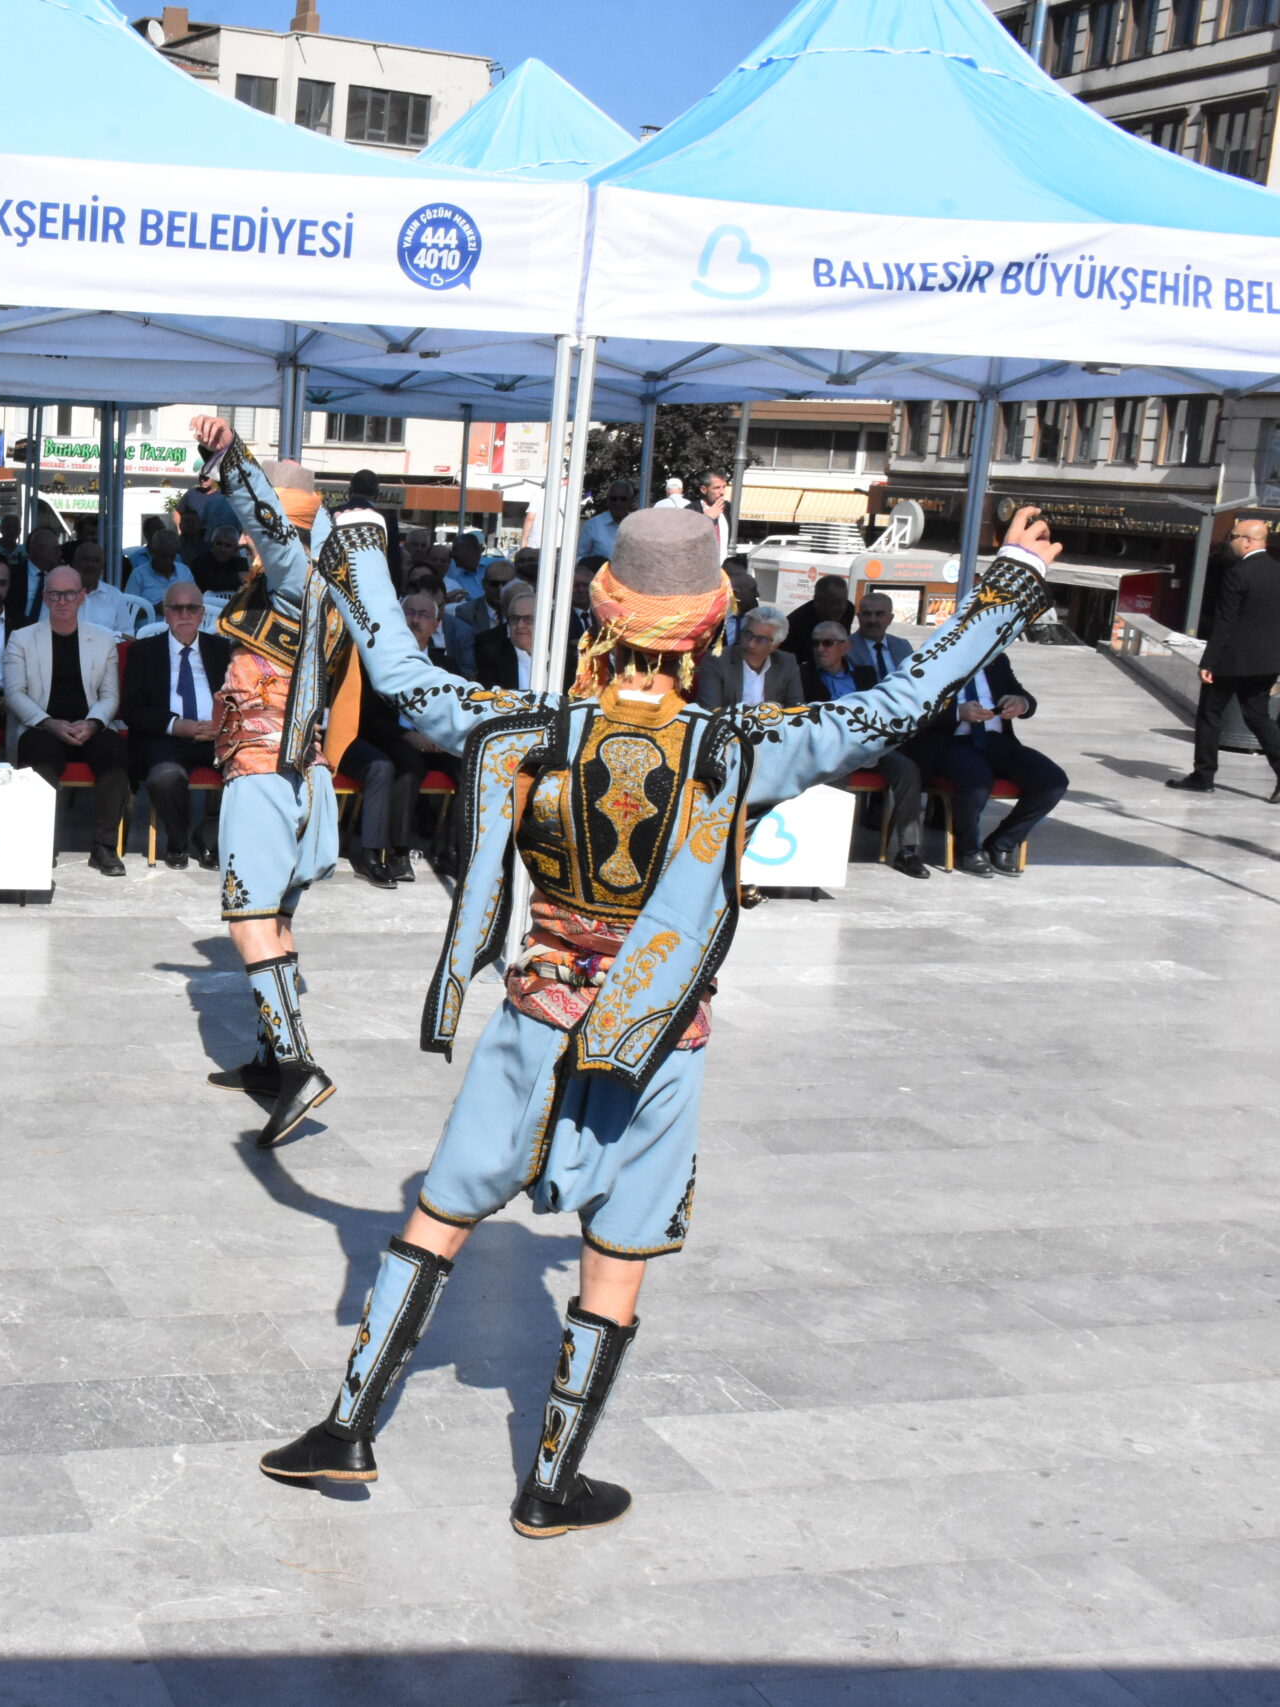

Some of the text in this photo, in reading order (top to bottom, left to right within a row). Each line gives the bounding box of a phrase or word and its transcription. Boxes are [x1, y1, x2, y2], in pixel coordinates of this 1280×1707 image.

[139, 207, 354, 259] BELEDİYESİ
[403, 207, 478, 251] YAKIN ÇÖZÜM MERKEZİ
[420, 226, 459, 249] 444
[413, 247, 461, 270] 4010
[813, 253, 1280, 315] BALIKESİR BÜYÜKŞEHİR BEL
[44, 437, 100, 463] BUHARA
[140, 442, 187, 466] PAZARI
